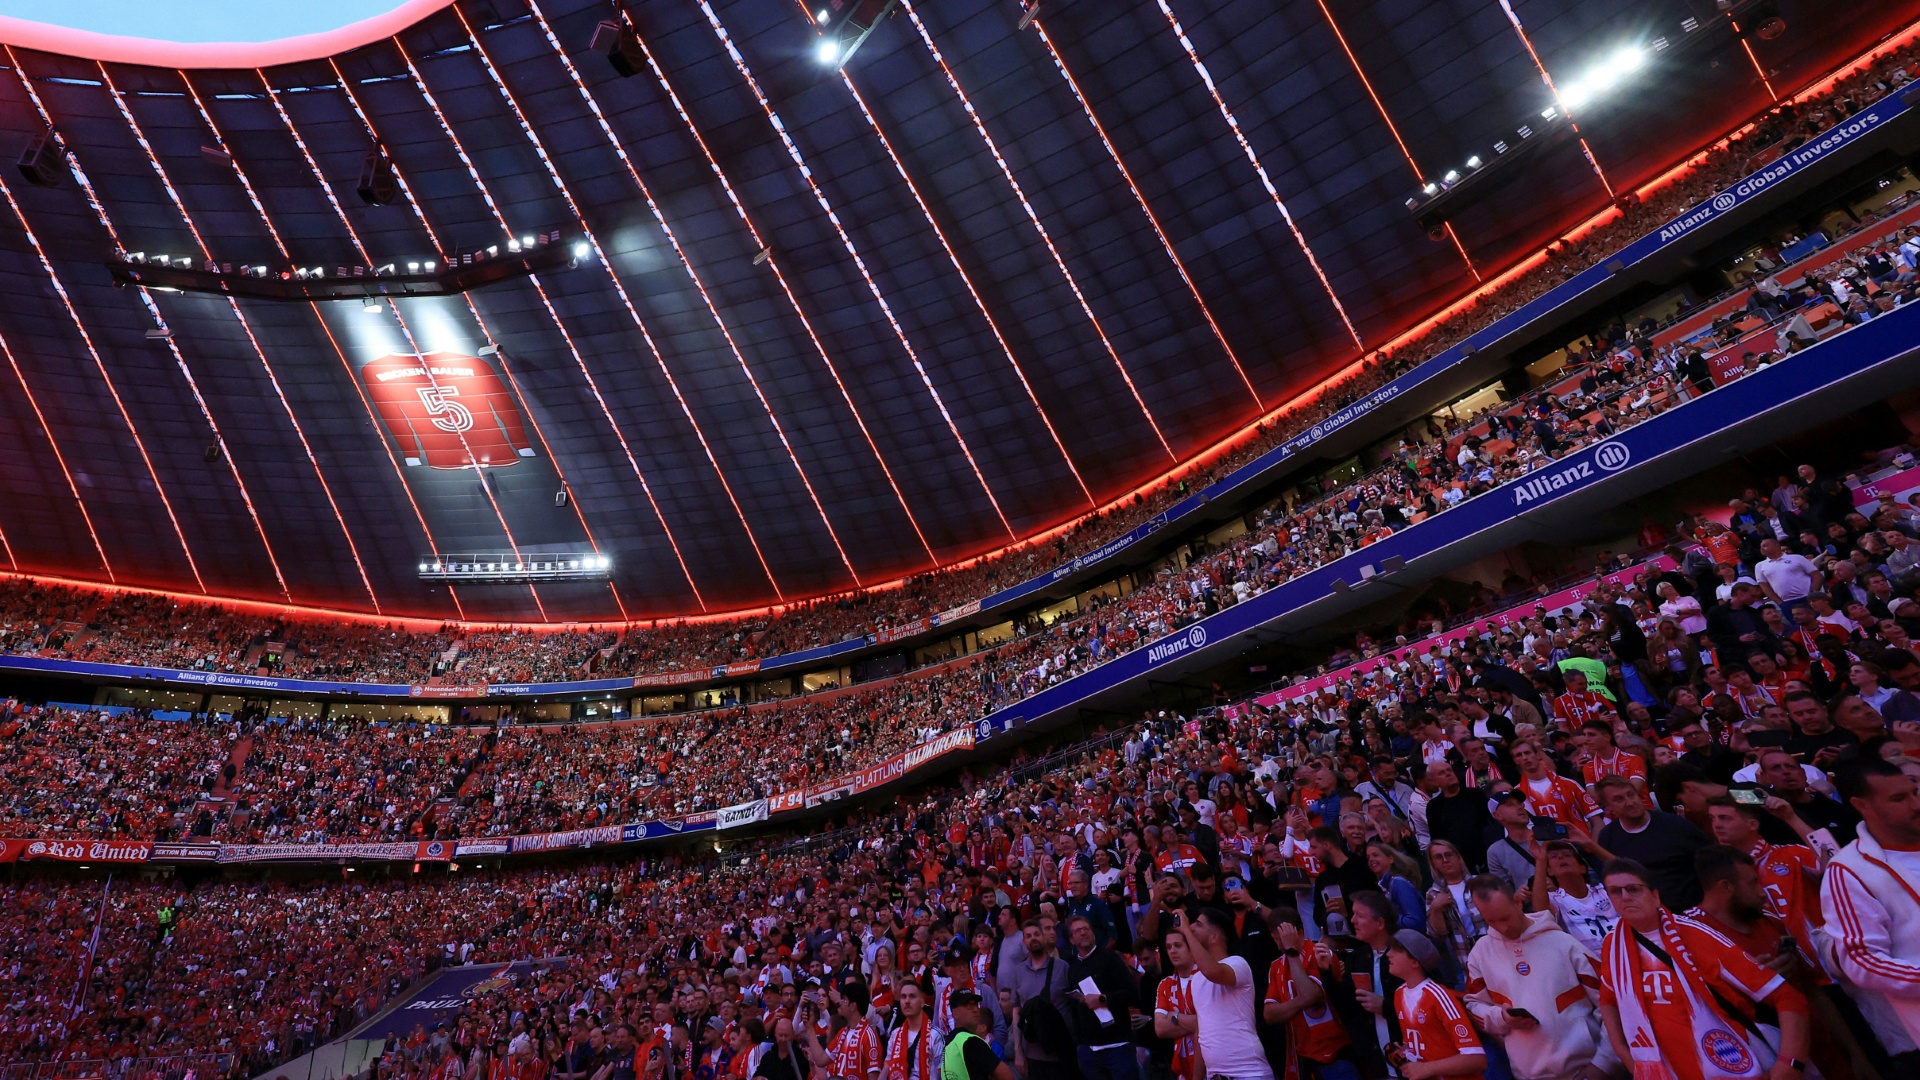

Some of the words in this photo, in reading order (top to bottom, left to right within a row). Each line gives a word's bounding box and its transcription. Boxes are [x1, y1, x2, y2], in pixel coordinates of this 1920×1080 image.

[1660, 205, 1713, 242] Allianz
[1736, 160, 1793, 197] Global
[1793, 112, 1879, 165] Investors
[1715, 355, 1729, 366] 210
[1723, 365, 1745, 379] Allia
[416, 386, 474, 432] 5
[1324, 409, 1353, 431] Global
[1354, 385, 1399, 414] Invstors
[1513, 460, 1595, 506] Allianz
[1083, 551, 1104, 565] Global
[1105, 535, 1133, 554] Investors
[1148, 637, 1189, 664] Allianz
[177, 673, 205, 681] Allianz
[218, 676, 242, 684] Global
[243, 678, 278, 687] Investors
[904, 727, 973, 770] WALDKIRCHEN
[855, 759, 904, 789] PLATTLING
[769, 795, 785, 810] AF
[787, 791, 803, 807] 94
[48, 841, 85, 859] Red
[89, 844, 149, 860] United
[187, 848, 216, 856] MÜNCHEN
[513, 835, 545, 852] BAVARIA
[1643, 970, 1673, 1004] T
